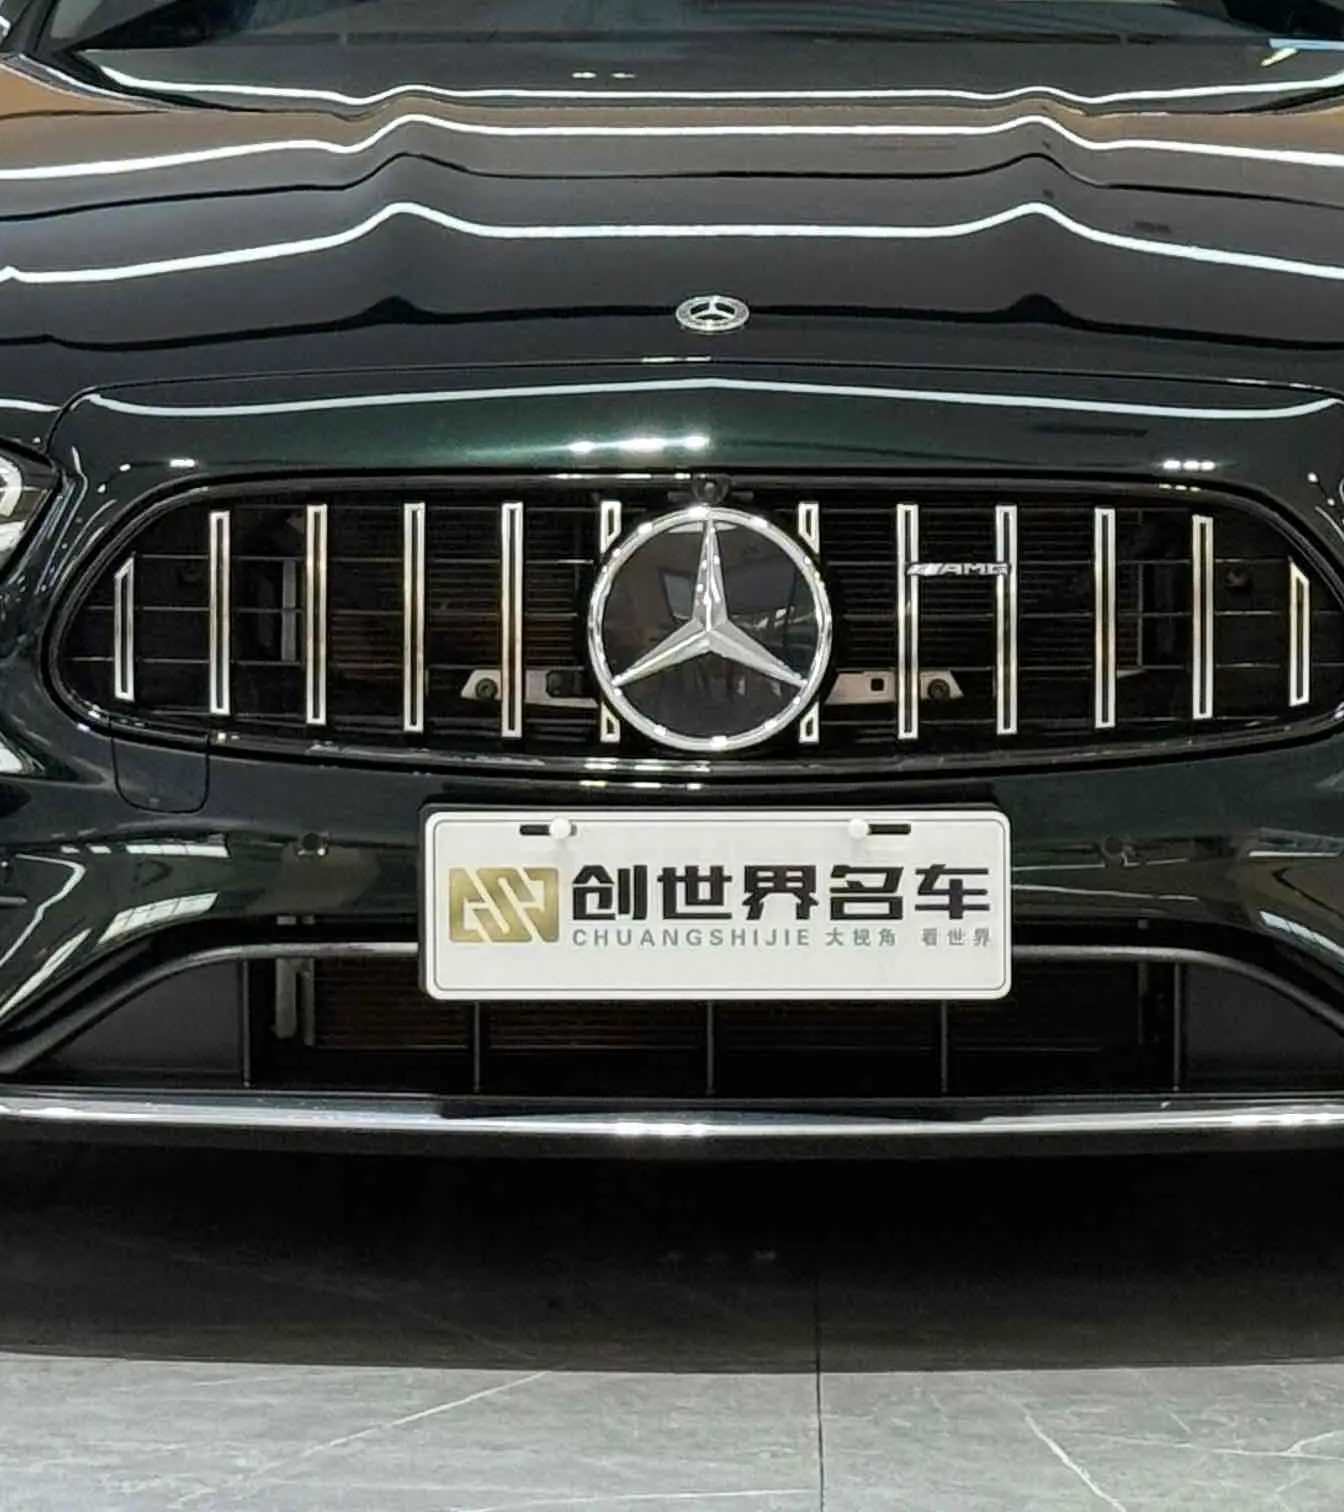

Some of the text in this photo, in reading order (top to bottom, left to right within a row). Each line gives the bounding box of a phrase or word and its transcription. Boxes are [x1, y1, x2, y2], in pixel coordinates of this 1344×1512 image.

[937, 562, 1009, 576] AMG
[571, 863, 991, 921] 创世界名车
[572, 927, 991, 947] CHUANGSHIJIE 大视角 看世界
